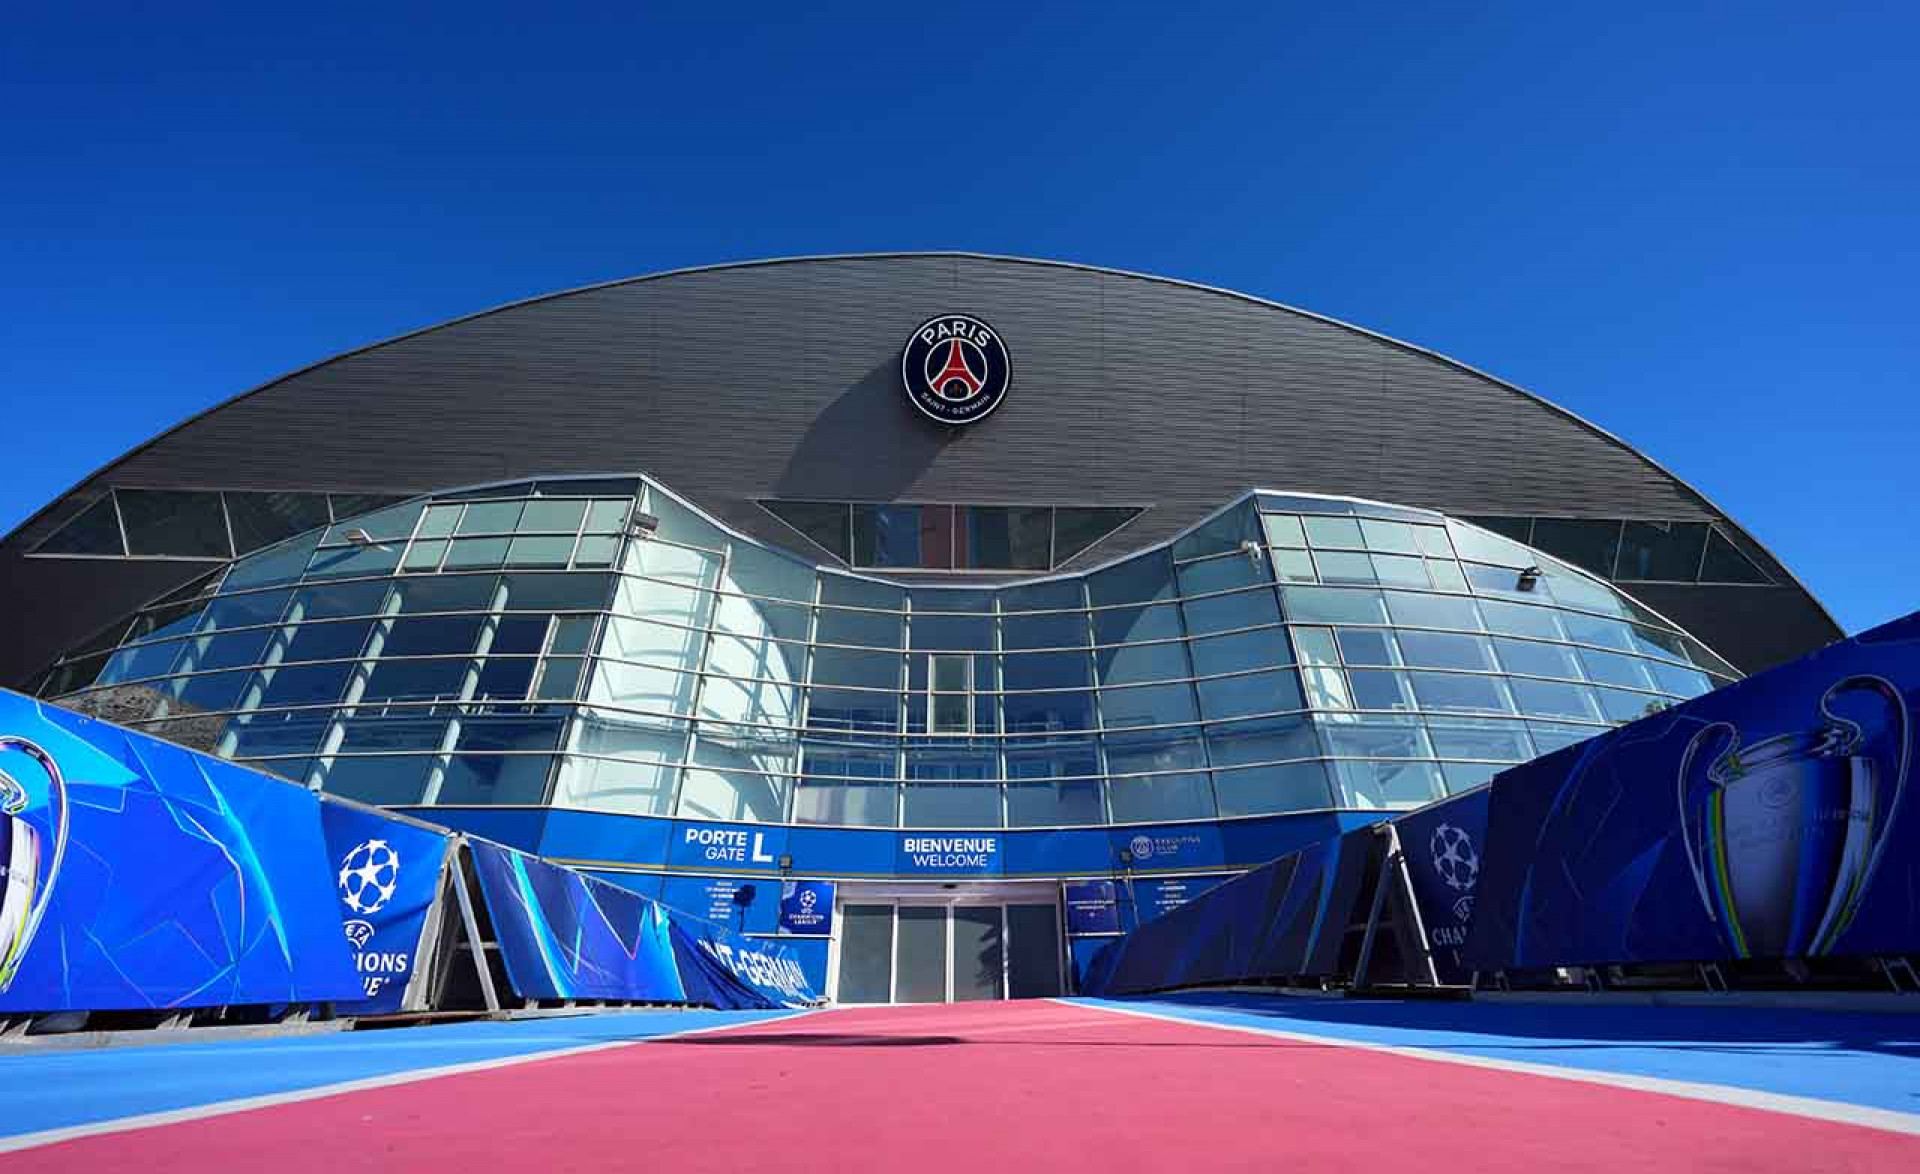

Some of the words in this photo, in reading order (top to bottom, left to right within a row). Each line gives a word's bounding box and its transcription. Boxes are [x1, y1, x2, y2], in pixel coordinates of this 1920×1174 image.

[921, 320, 991, 347] PARIS
[685, 828, 748, 847] PORTE
[904, 838, 996, 853] BIENVENUE
[705, 846, 745, 862] GATE
[752, 833, 773, 863] L
[913, 854, 988, 868] WELCOME
